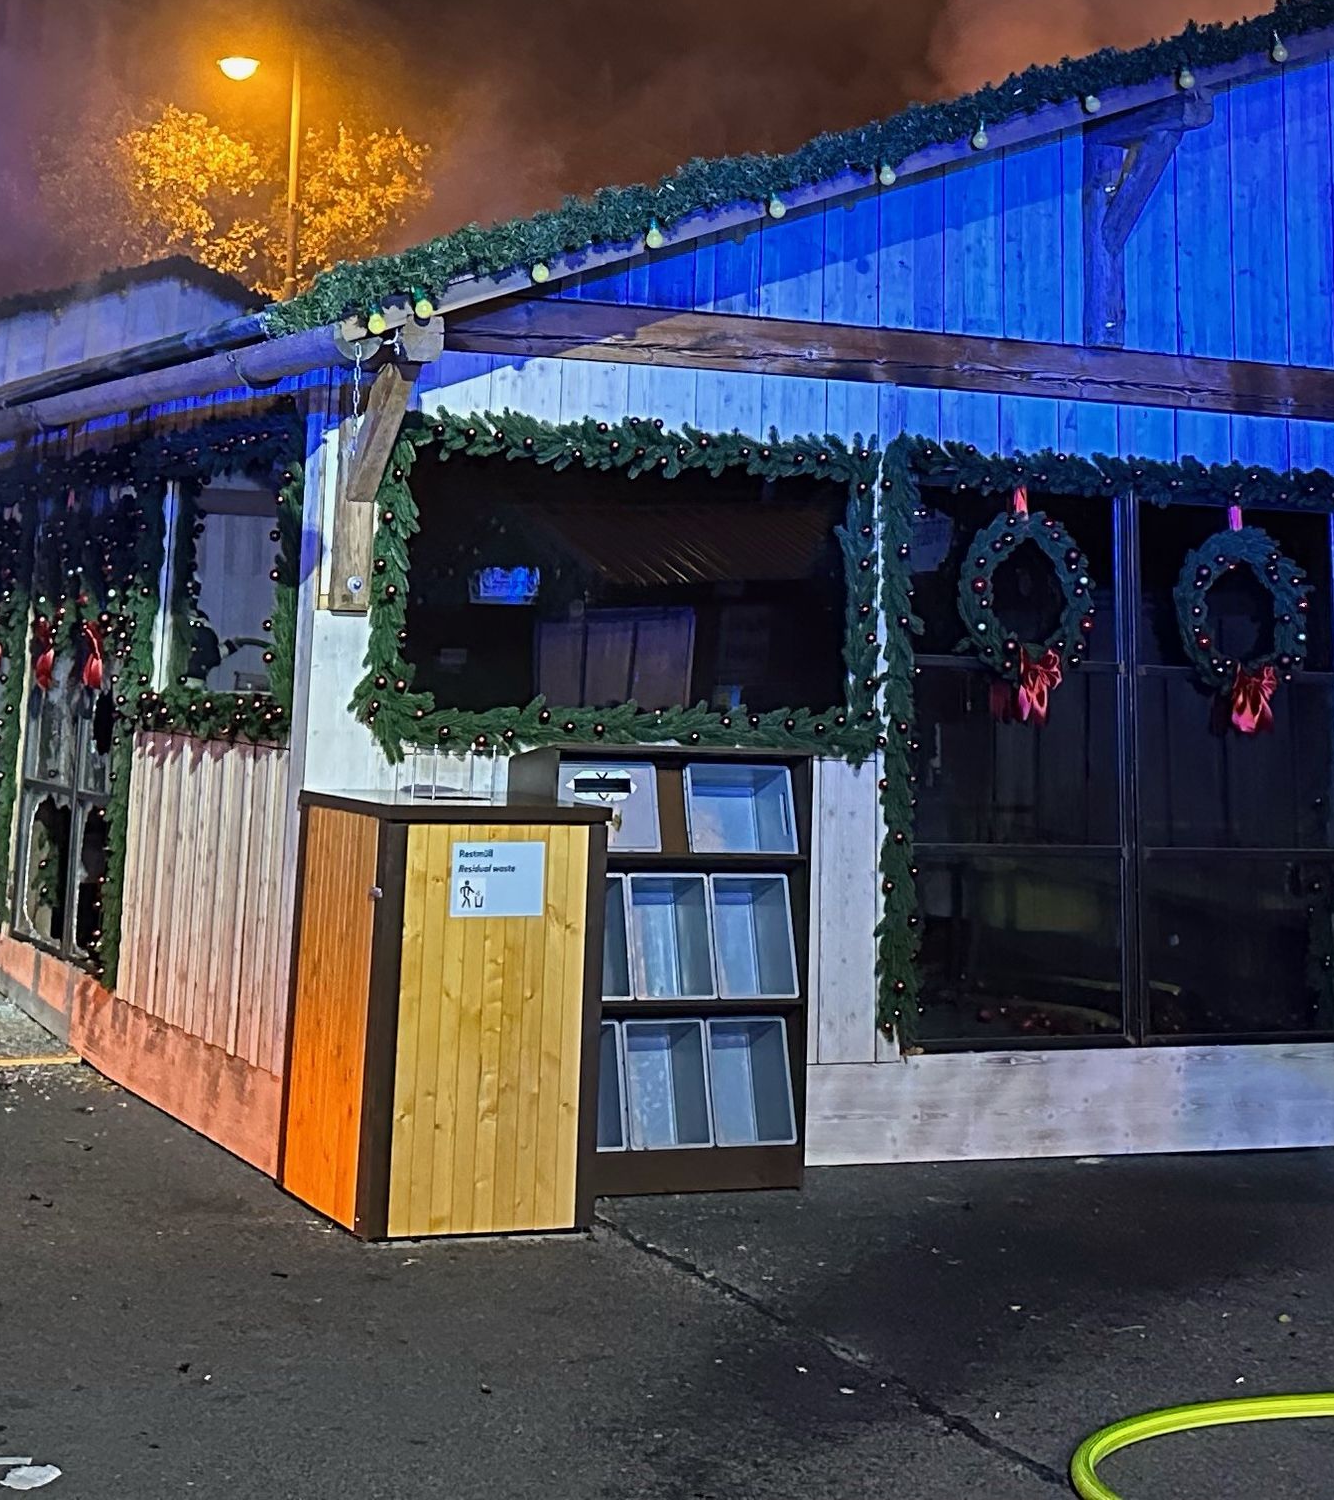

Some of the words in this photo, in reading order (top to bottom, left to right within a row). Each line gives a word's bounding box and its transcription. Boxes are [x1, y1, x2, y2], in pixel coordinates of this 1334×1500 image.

[459, 848, 494, 858] Restmüll
[458, 864, 492, 873] Residual
[493, 865, 516, 873] waste
